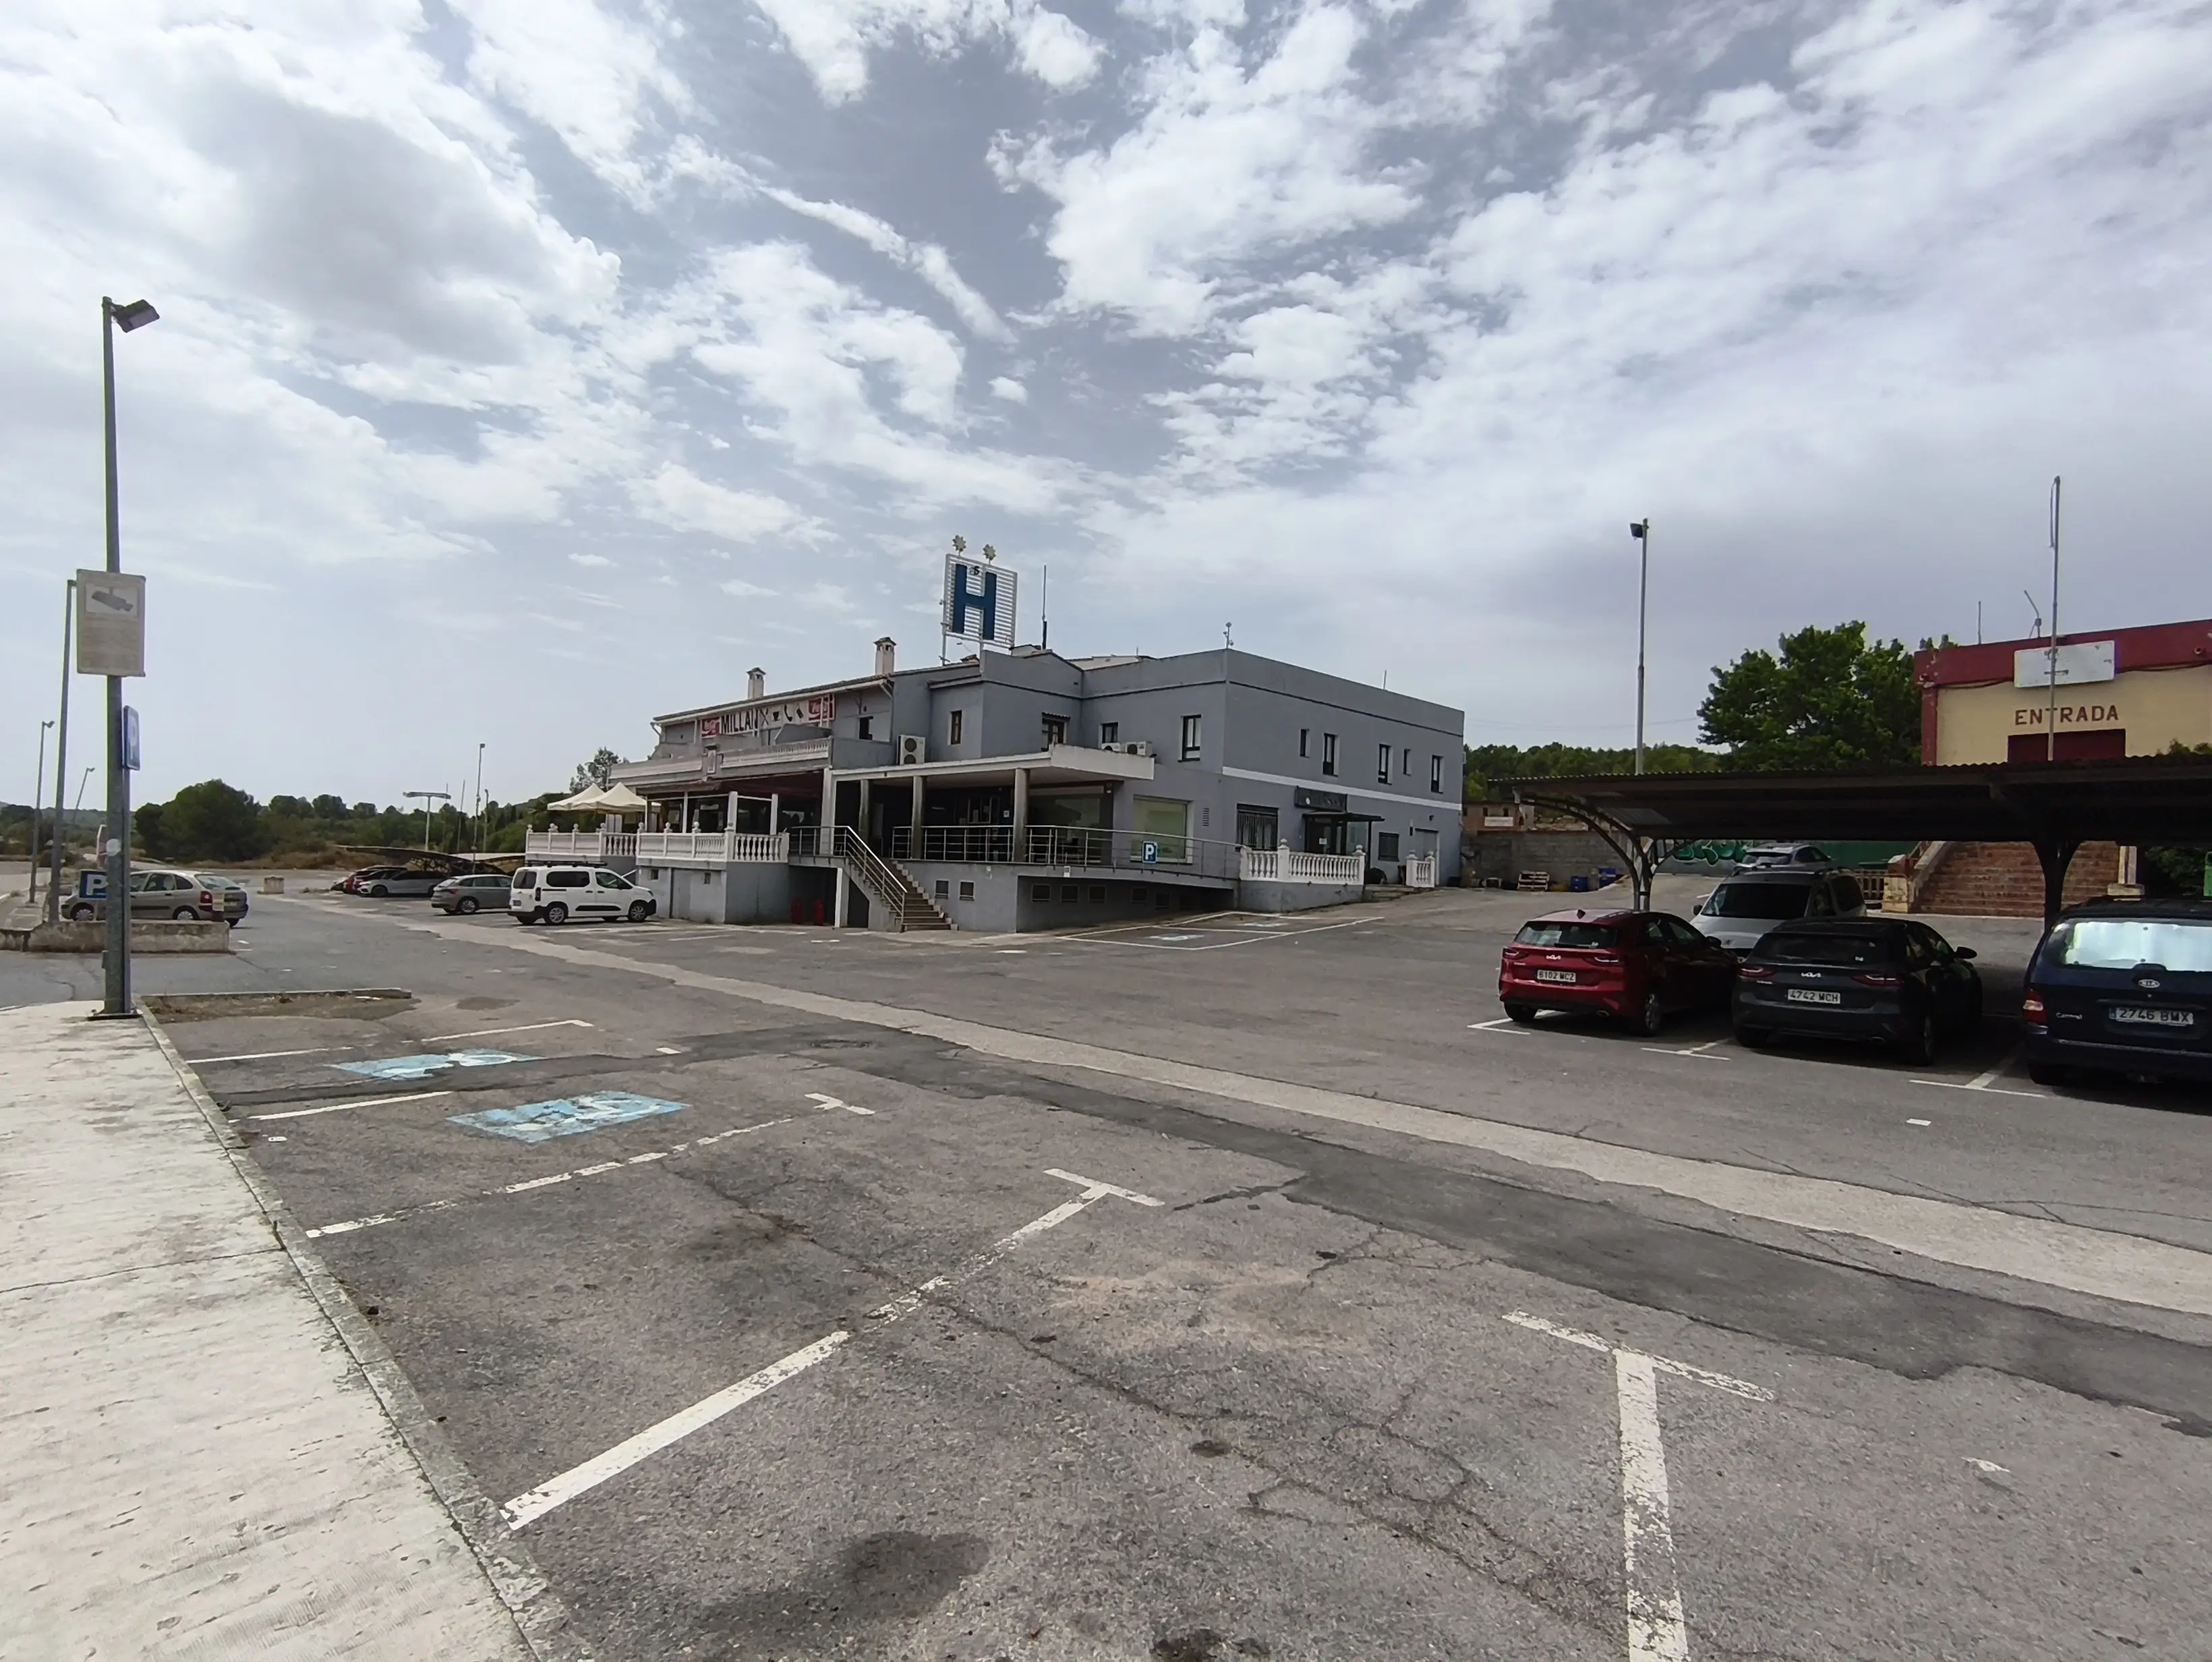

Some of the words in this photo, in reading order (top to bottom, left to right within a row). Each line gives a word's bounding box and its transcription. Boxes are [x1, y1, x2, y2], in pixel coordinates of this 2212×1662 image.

[952, 563, 997, 640] H
[1145, 844, 1155, 860] P
[85, 873, 108, 896] P
[1790, 990, 1815, 1000] 4742
[2119, 1008, 2155, 1021] 2746
[2160, 1010, 2189, 1022] BMX
